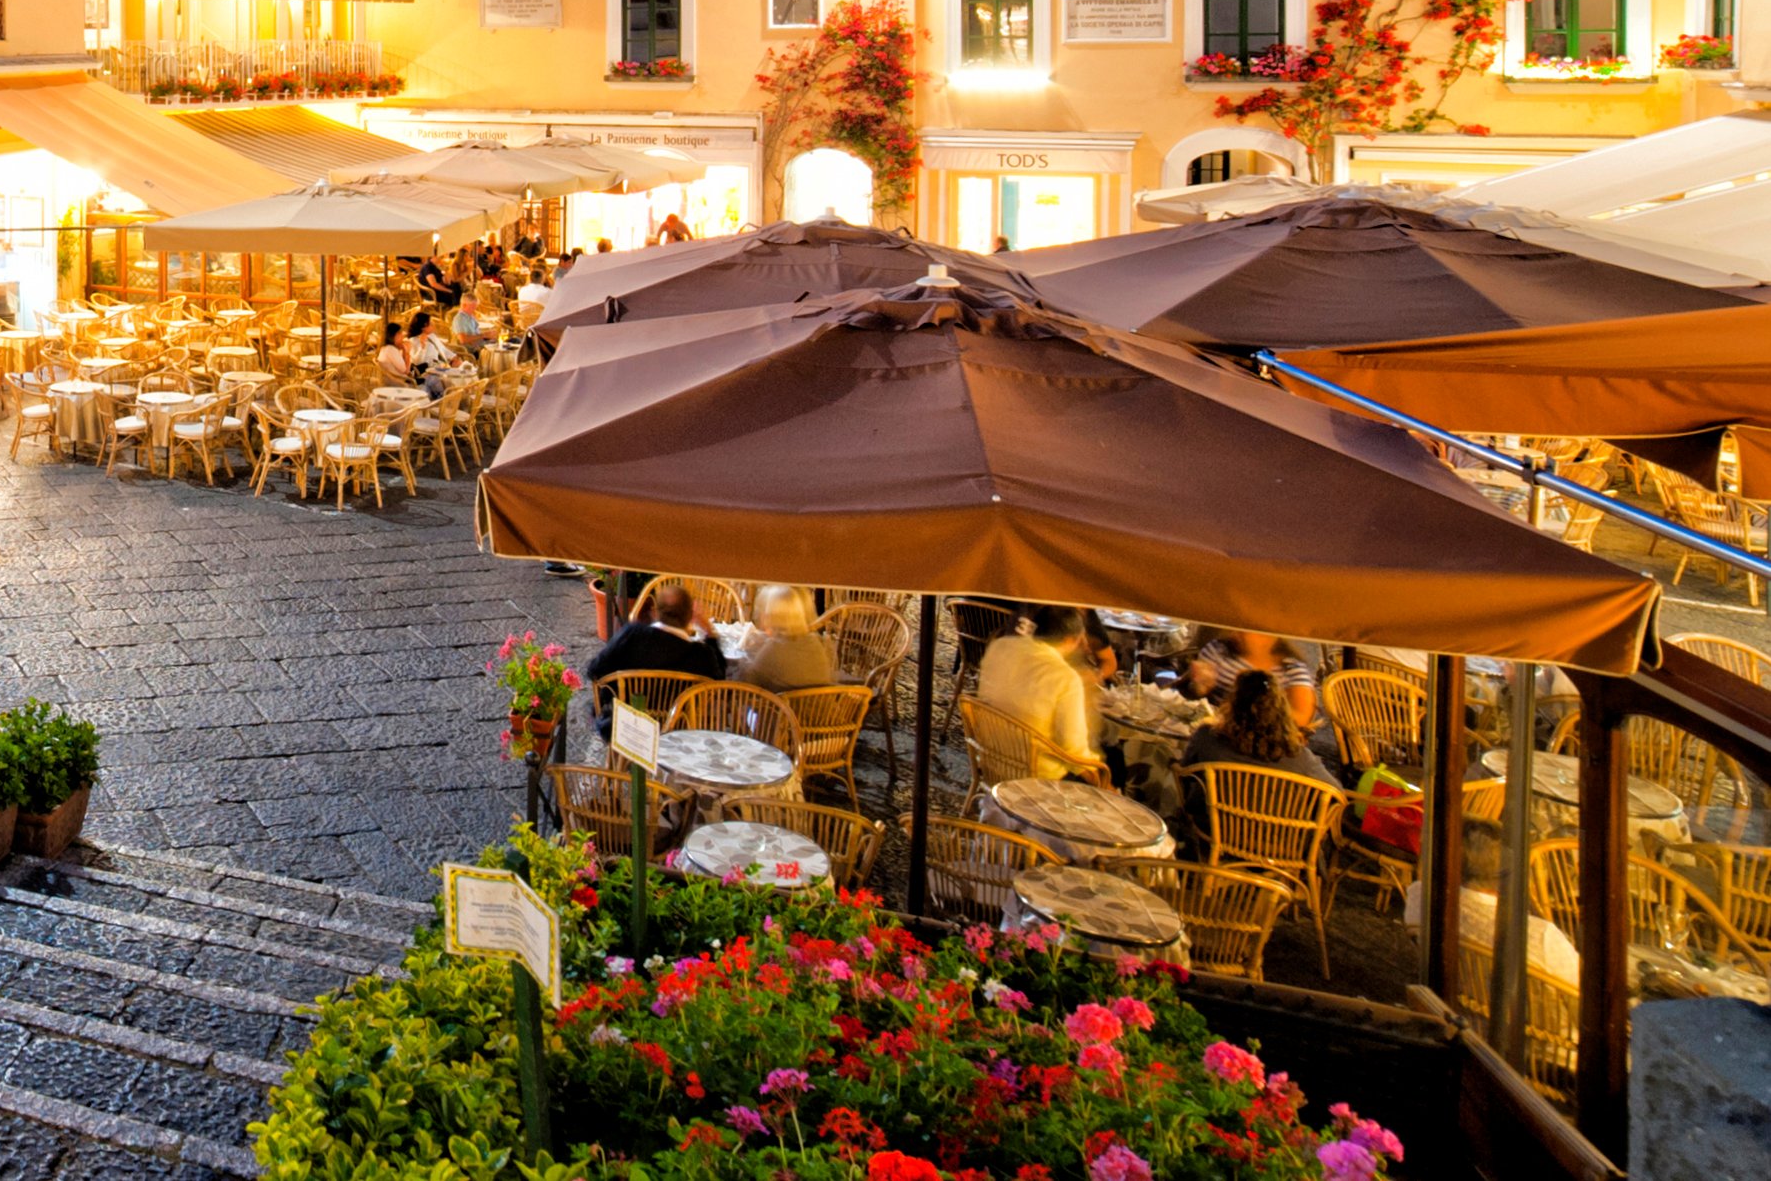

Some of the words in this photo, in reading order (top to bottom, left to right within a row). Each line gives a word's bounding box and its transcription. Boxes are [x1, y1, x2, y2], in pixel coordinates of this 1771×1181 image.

[417, 129, 462, 139] Parisienne
[467, 129, 508, 140] boutique
[607, 133, 658, 145] Parisienne
[664, 134, 710, 148] boutique
[996, 153, 1049, 169] TOD'S
